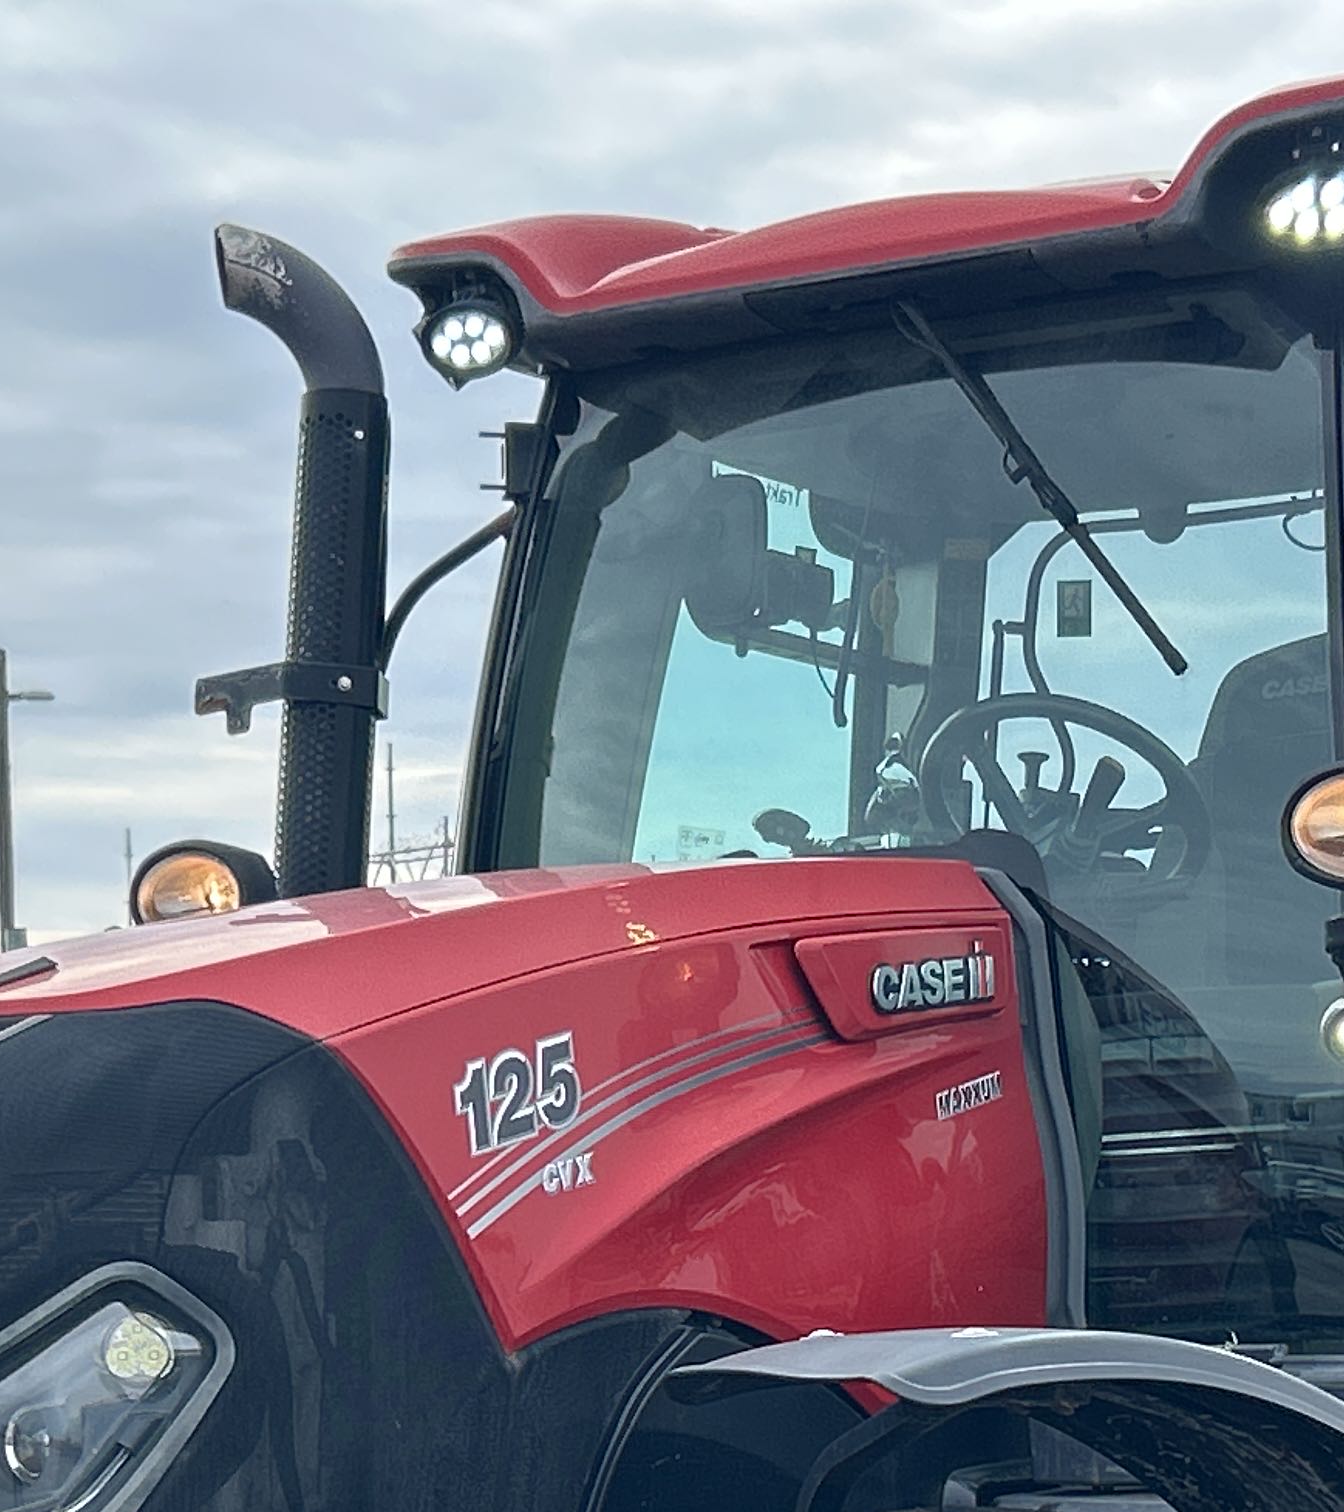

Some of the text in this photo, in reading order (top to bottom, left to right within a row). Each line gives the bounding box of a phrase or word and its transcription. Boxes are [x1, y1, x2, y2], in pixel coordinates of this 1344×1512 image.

[872, 958, 966, 1011] CASE
[453, 1029, 582, 1158] 125
[935, 1070, 1003, 1121] MAXXUM
[542, 1151, 597, 1196] CVX
